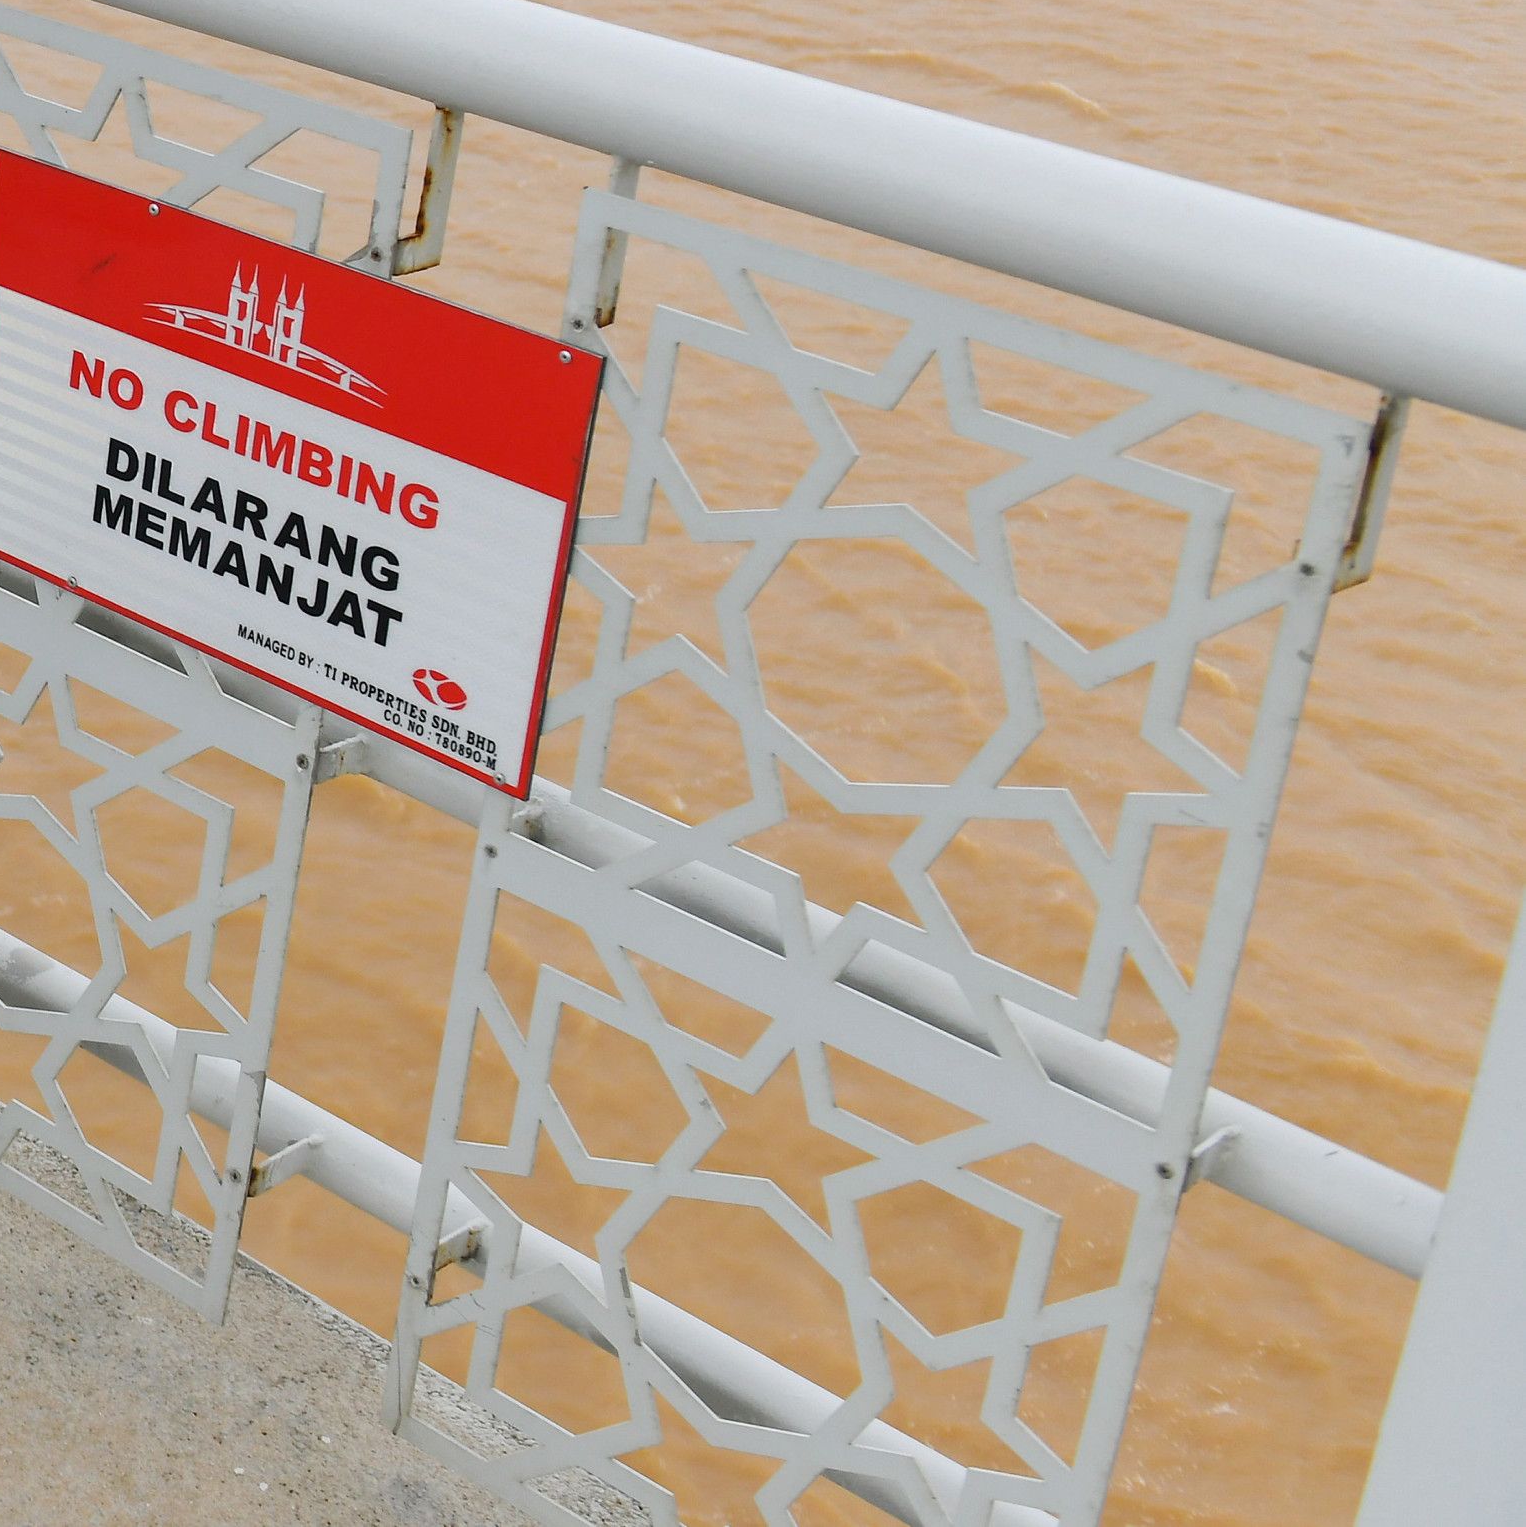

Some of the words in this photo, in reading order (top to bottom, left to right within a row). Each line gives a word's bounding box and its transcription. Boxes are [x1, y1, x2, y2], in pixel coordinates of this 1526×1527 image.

[69, 350, 143, 410] NO
[164, 390, 439, 529] CLIMBING
[106, 437, 400, 591] DILARANG
[92, 484, 403, 647] MEMANJAT
[237, 624, 296, 661] MANAGED
[298, 652, 314, 669] BY
[324, 663, 338, 681] TI
[341, 672, 427, 723] PROPERTIES
[431, 715, 461, 740] SDN.
[467, 730, 498, 757] BHD.
[383, 709, 403, 727] CO.
[435, 732, 497, 770] 780890-M
